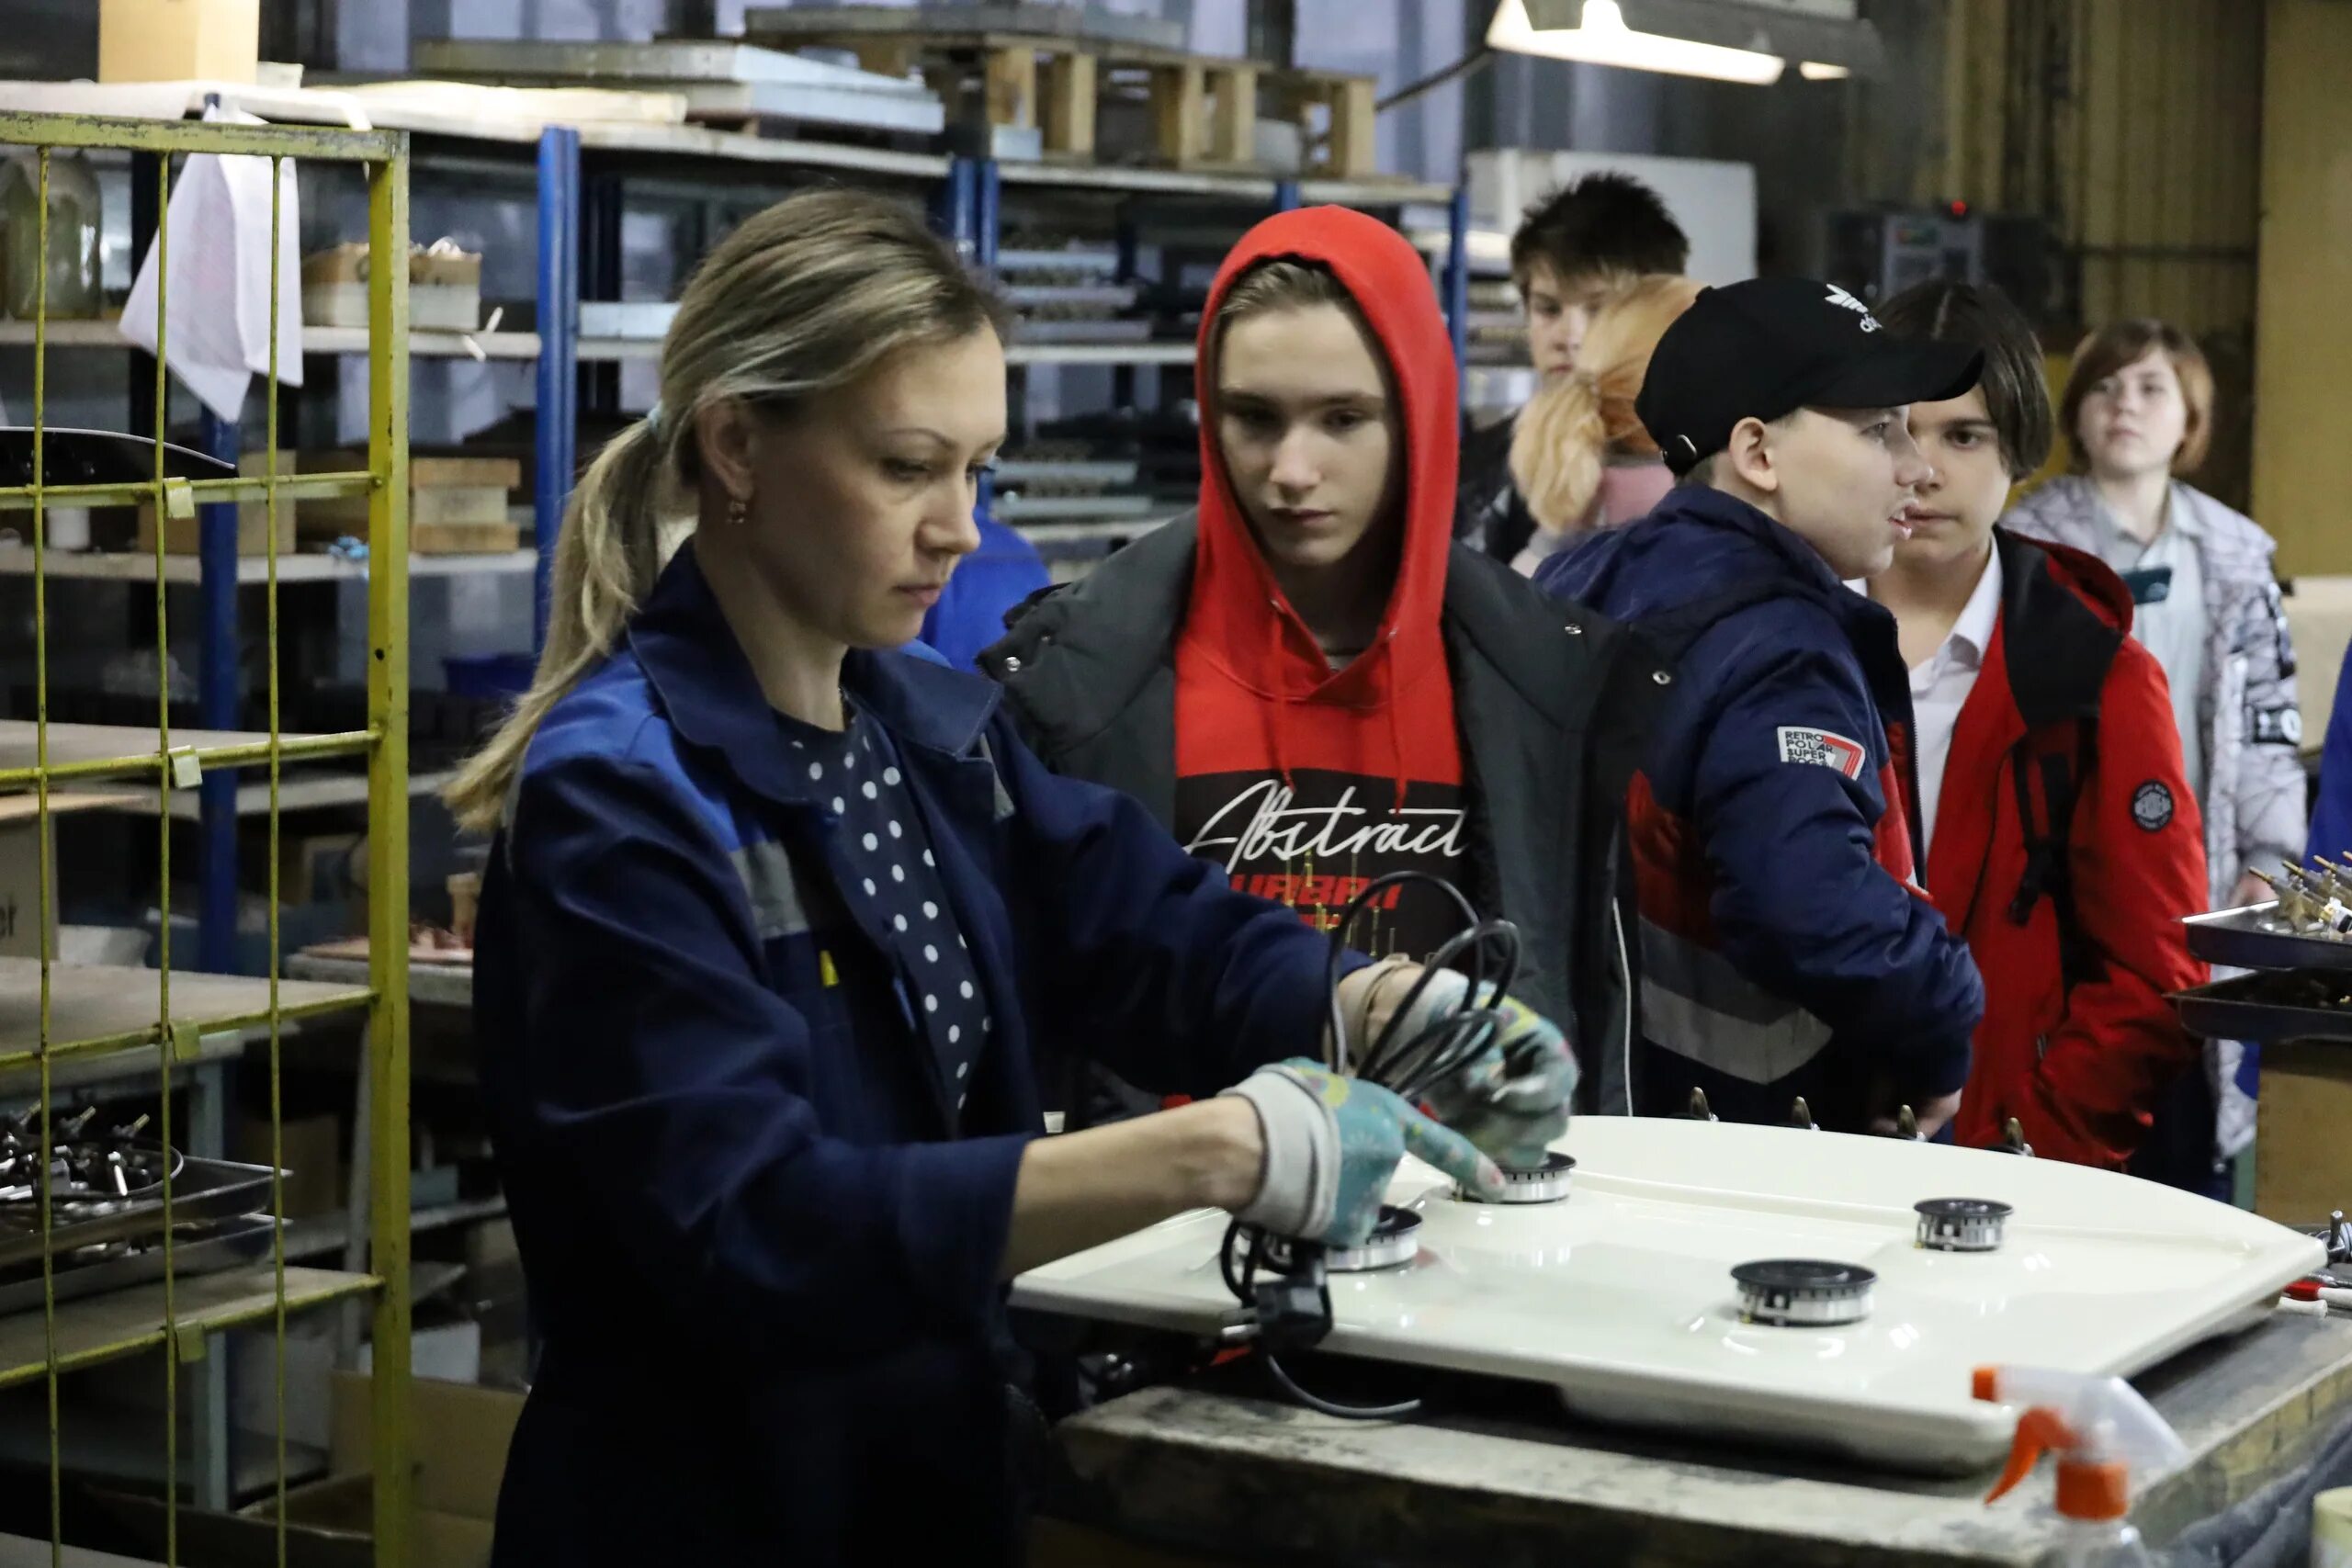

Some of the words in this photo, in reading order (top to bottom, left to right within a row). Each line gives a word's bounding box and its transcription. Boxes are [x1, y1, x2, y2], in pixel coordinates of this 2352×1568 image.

[1784, 731, 1824, 742] RETRO
[1786, 739, 1834, 753] POLAR
[1787, 748, 1826, 760] SUPER
[1182, 779, 1469, 874] Abstract
